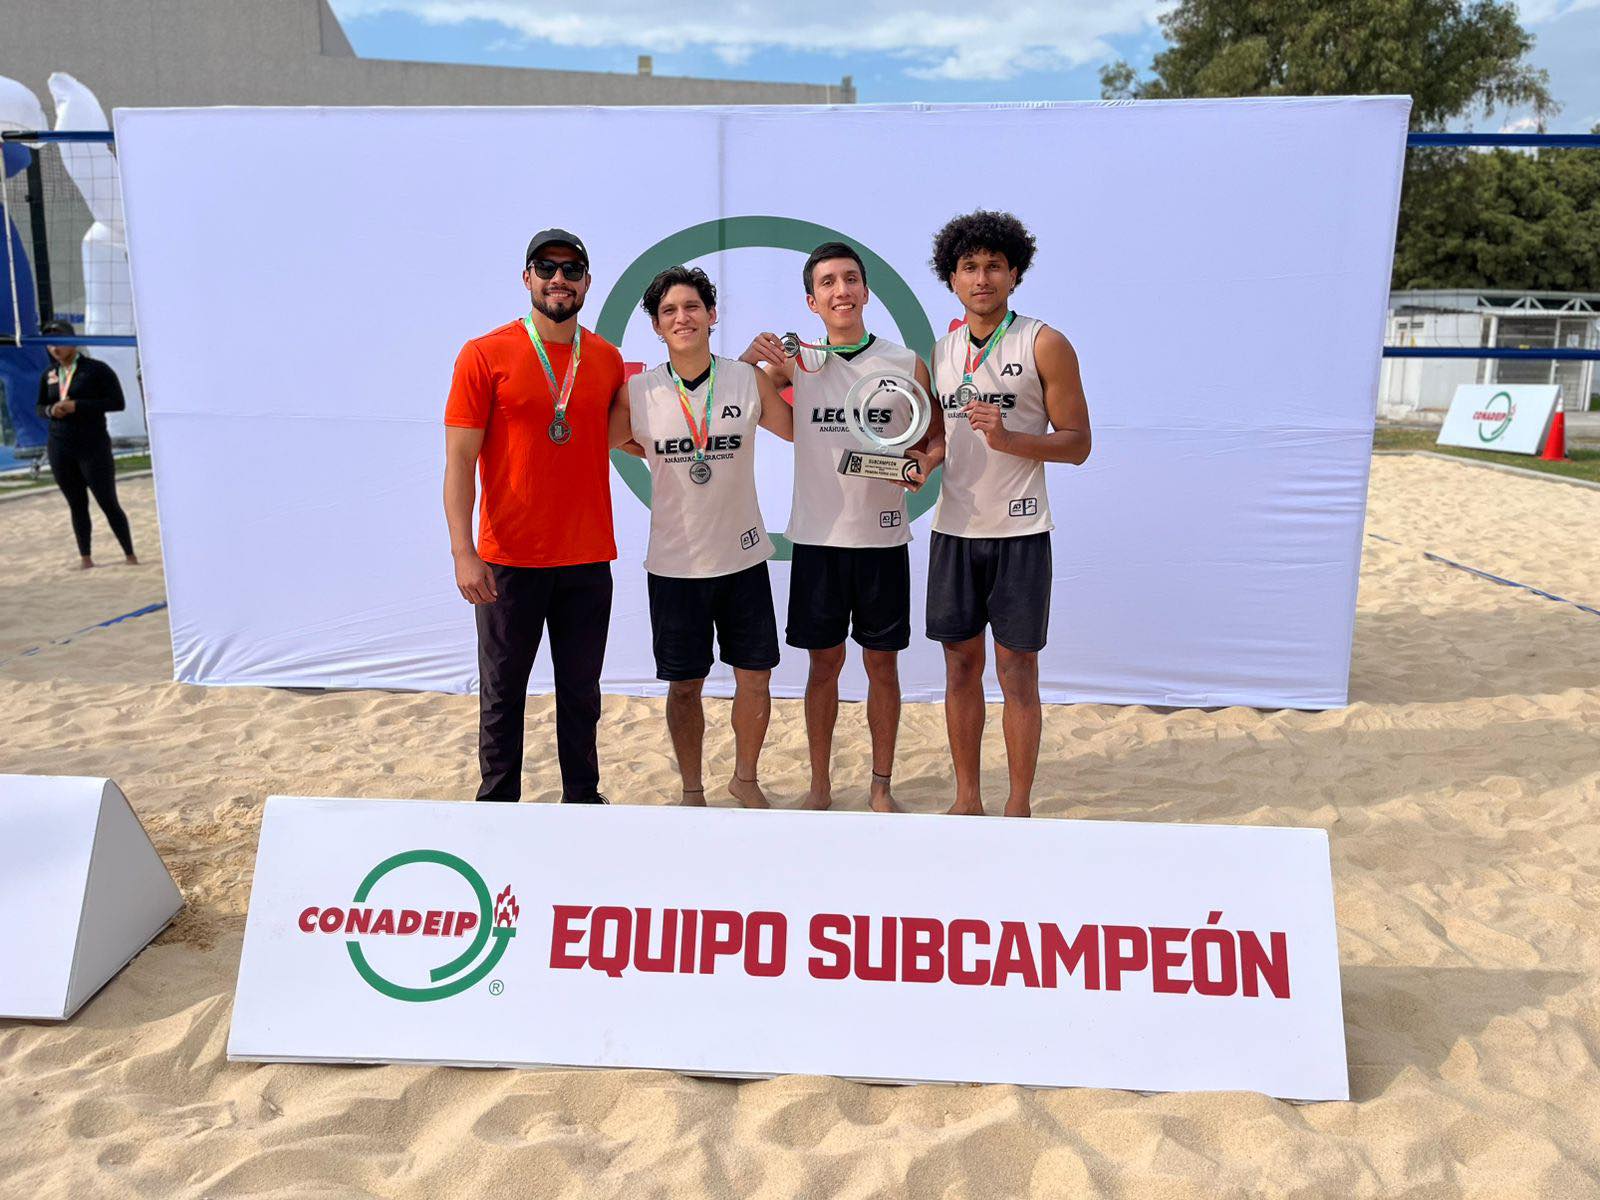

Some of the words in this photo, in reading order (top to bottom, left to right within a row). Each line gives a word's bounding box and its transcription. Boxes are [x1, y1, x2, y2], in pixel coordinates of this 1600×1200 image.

[942, 394, 1016, 409] LENES
[703, 453, 734, 461] ERACRUZ
[300, 908, 477, 936] CONADEIP
[551, 906, 787, 977] EQUIPO
[809, 912, 1290, 998] SUBCAMPEÓN
